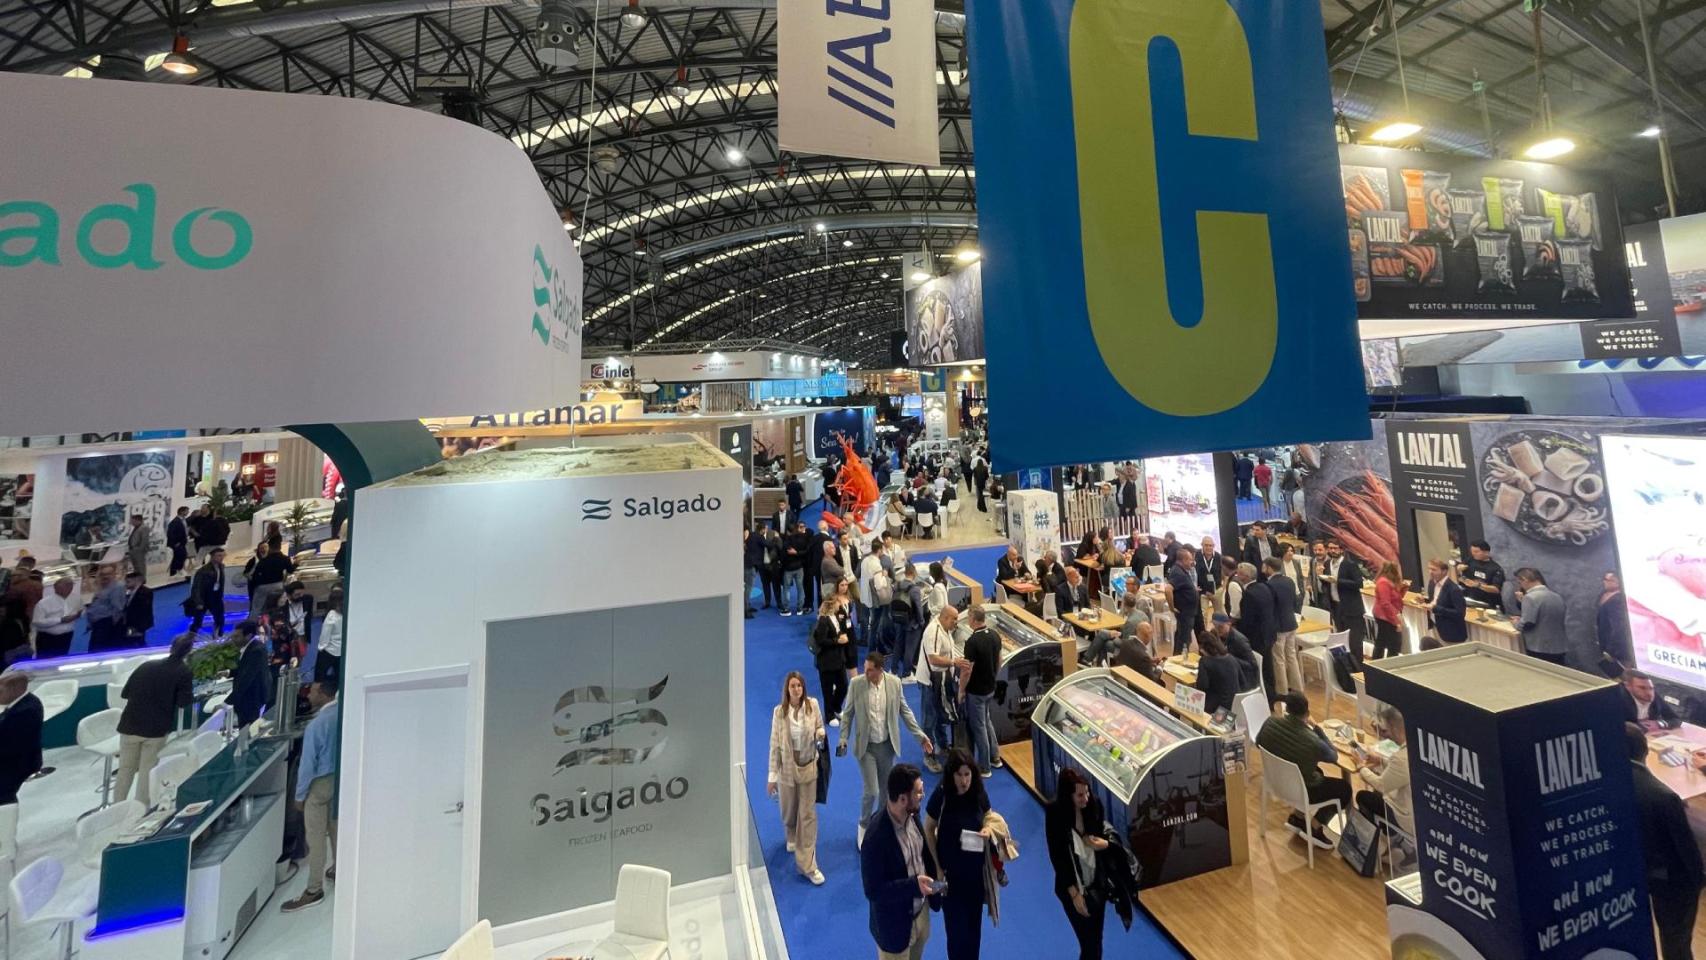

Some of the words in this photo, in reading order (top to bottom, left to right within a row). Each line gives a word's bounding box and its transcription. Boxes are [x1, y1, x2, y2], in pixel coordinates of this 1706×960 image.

[1614, 335, 1664, 343] PROCESS.
[1619, 328, 1656, 336] CATCH.
[1621, 342, 1658, 350] TRADE.
[1397, 431, 1467, 469] LANZAL
[1424, 485, 1462, 495] PROCESS.
[1427, 479, 1456, 487] CATCH.
[1430, 492, 1458, 501] TRADE.
[623, 493, 722, 519] Salgado
[1417, 727, 1485, 790] LANZAL
[1535, 729, 1602, 795] LANZAL
[1422, 790, 1437, 802] WE
[1440, 799, 1490, 830] PROCESS.
[1427, 783, 1441, 796] WE
[1445, 793, 1483, 816] CATCH.
[1429, 801, 1443, 815] WE
[1448, 811, 1485, 836] TRADE.
[1545, 818, 1563, 832] WE
[1568, 805, 1609, 825] CATCH.
[1430, 828, 1453, 847] and
[1460, 842, 1489, 863] now
[1540, 838, 1559, 852] WE
[1564, 820, 1618, 846] PROCESS.
[1425, 841, 1448, 866] WE
[1453, 857, 1497, 892] EVEN
[1550, 853, 1569, 868] WE
[1573, 839, 1614, 861] TRADE.
[1434, 869, 1497, 919] COOK
[1553, 880, 1580, 912] and
[1585, 868, 1613, 897] now
[1538, 925, 1561, 952] WE
[1563, 907, 1599, 941] EVEN
[1602, 887, 1637, 922] COOK
